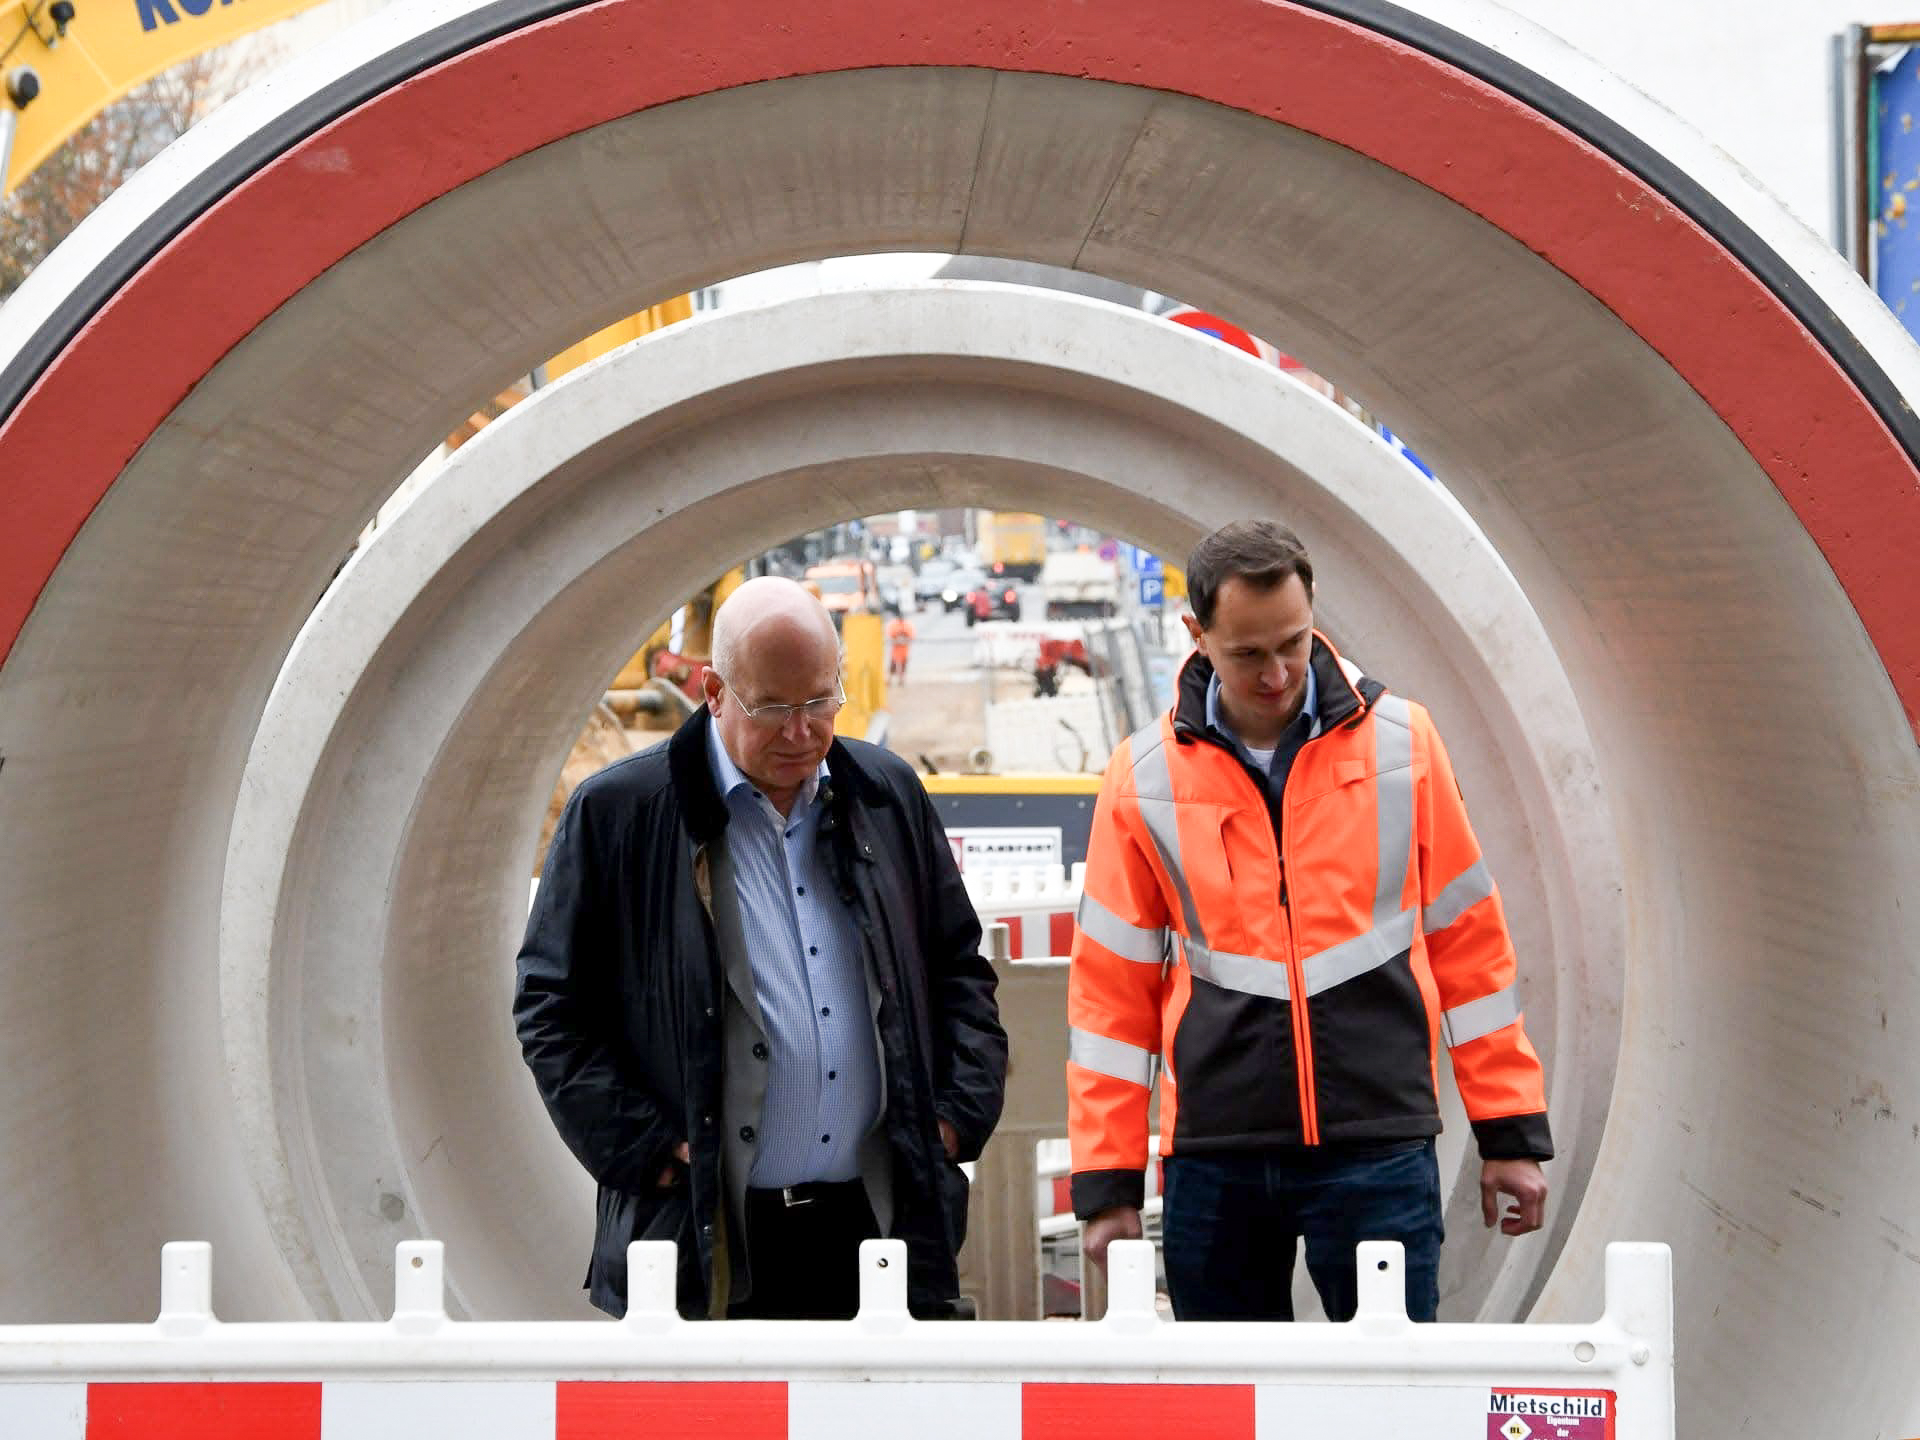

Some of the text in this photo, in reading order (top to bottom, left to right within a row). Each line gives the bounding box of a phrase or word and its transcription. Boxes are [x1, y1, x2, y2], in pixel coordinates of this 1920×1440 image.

[1143, 579, 1161, 602] P
[1490, 1395, 1602, 1416] Mietschild
[1556, 1428, 1570, 1437] der
